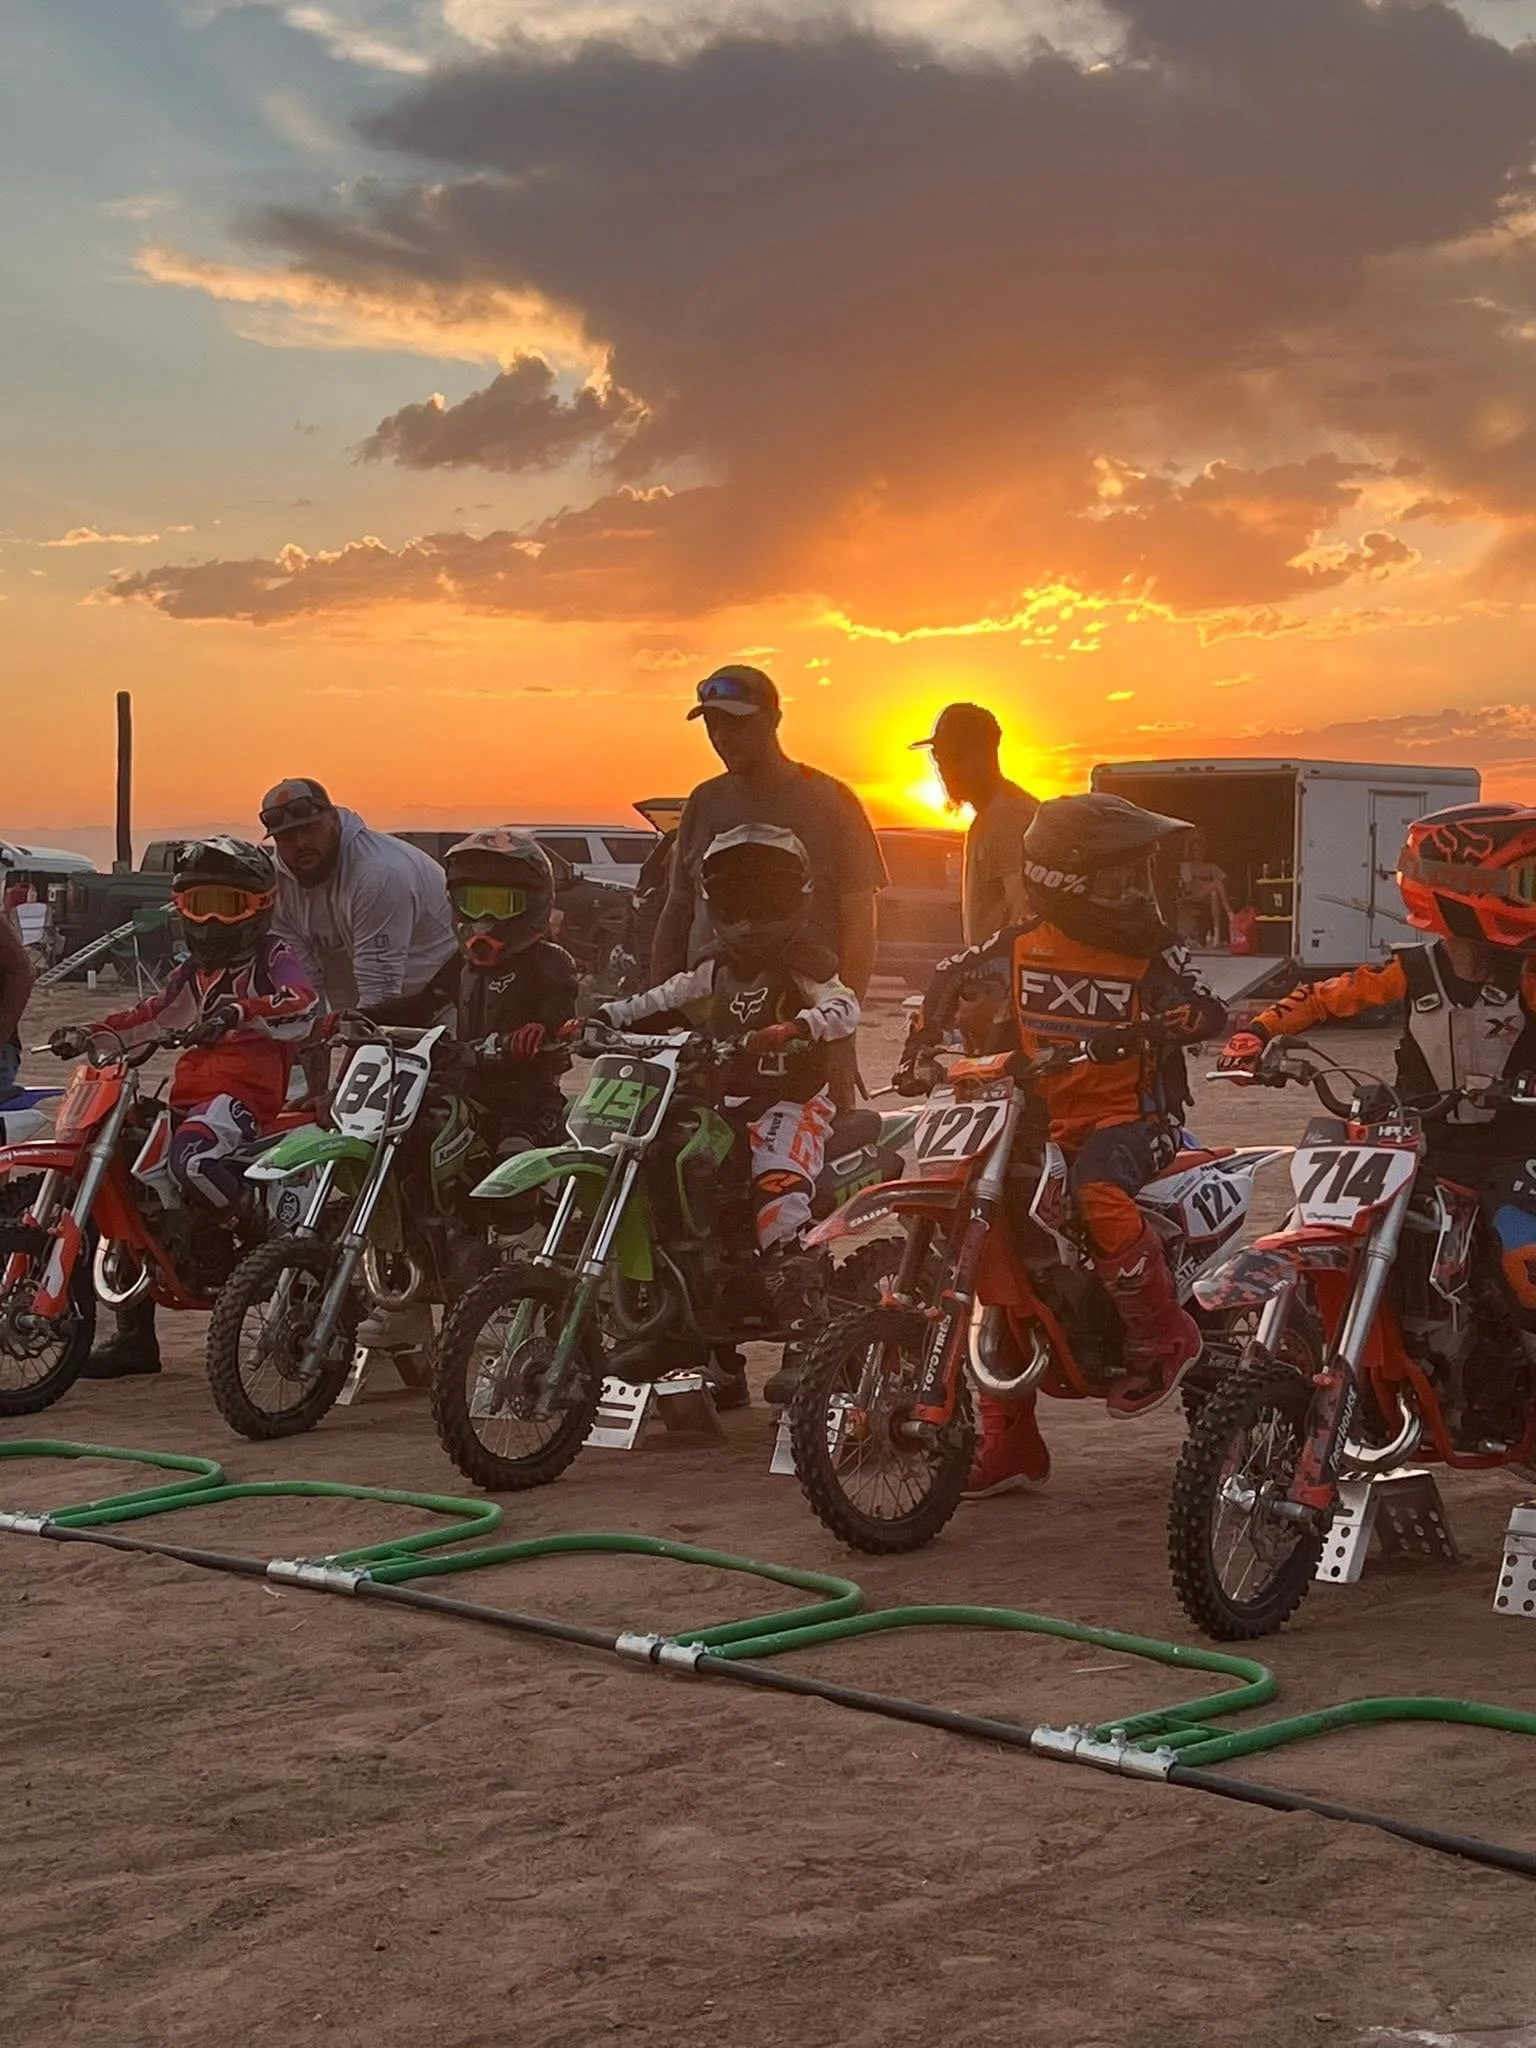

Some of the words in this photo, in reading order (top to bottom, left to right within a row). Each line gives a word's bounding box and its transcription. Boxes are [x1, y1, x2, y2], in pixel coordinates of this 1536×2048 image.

[1023, 860, 1088, 894] 100%
[1020, 969, 1132, 1017] FXR
[337, 1061, 419, 1120] 84
[917, 1105, 1001, 1159] 121
[1298, 1150, 1396, 1206] 714
[1191, 1179, 1242, 1232] 121
